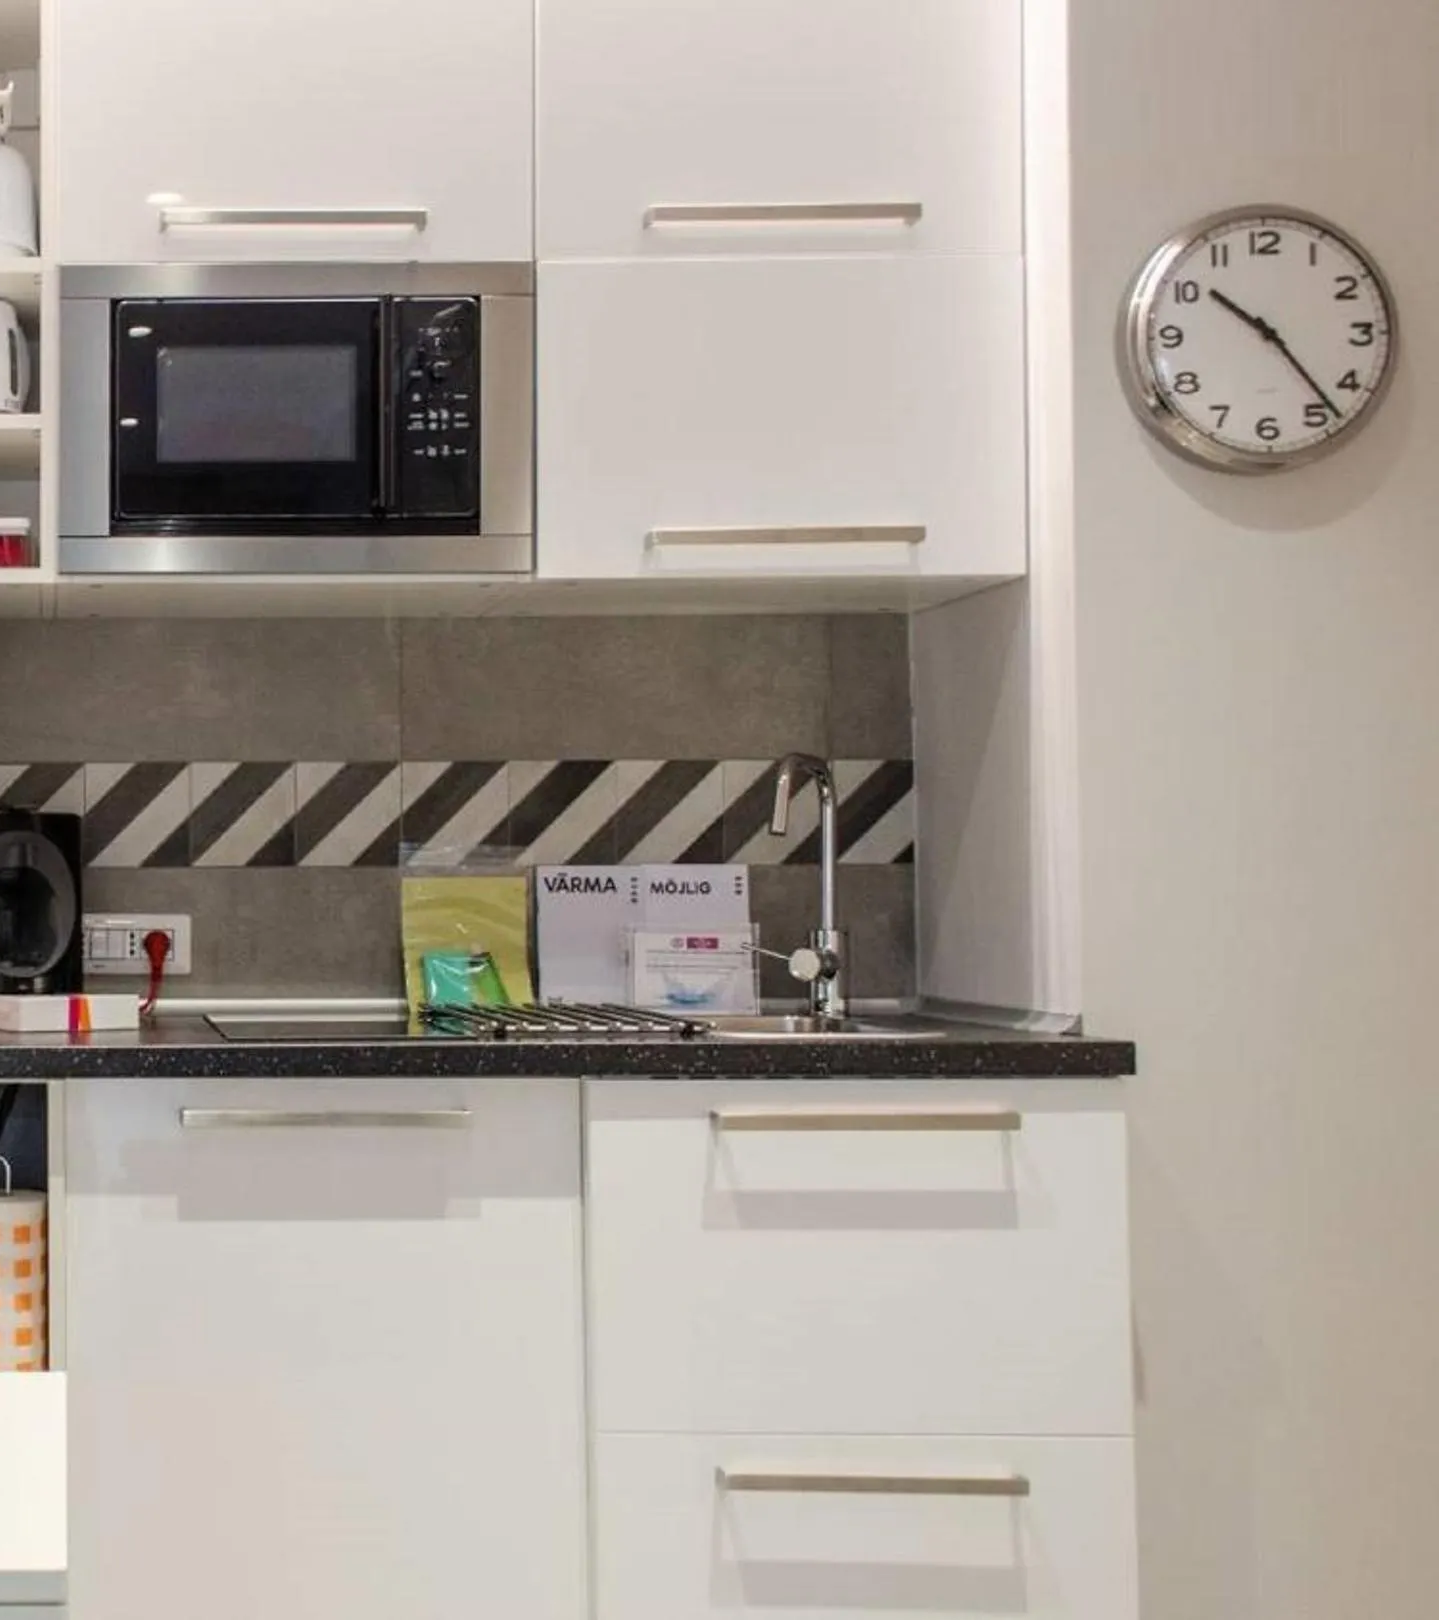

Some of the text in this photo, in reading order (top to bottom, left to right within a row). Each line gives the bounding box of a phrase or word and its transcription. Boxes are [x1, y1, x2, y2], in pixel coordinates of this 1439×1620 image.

[1249, 231, 1280, 255] 12
[1309, 243, 1316, 266] 1
[1211, 244, 1228, 267] 11
[1175, 280, 1200, 304] 10
[1335, 276, 1358, 300] 2
[1159, 325, 1183, 348] 9
[1349, 322, 1373, 346] 3
[1173, 372, 1200, 394] 8
[1337, 369, 1361, 392] 4
[1209, 405, 1230, 428] 7
[1303, 404, 1328, 427] 5
[1255, 417, 1280, 440] 6
[543, 873, 618, 893] VÄRMA
[650, 879, 712, 895] MÖJLIG
